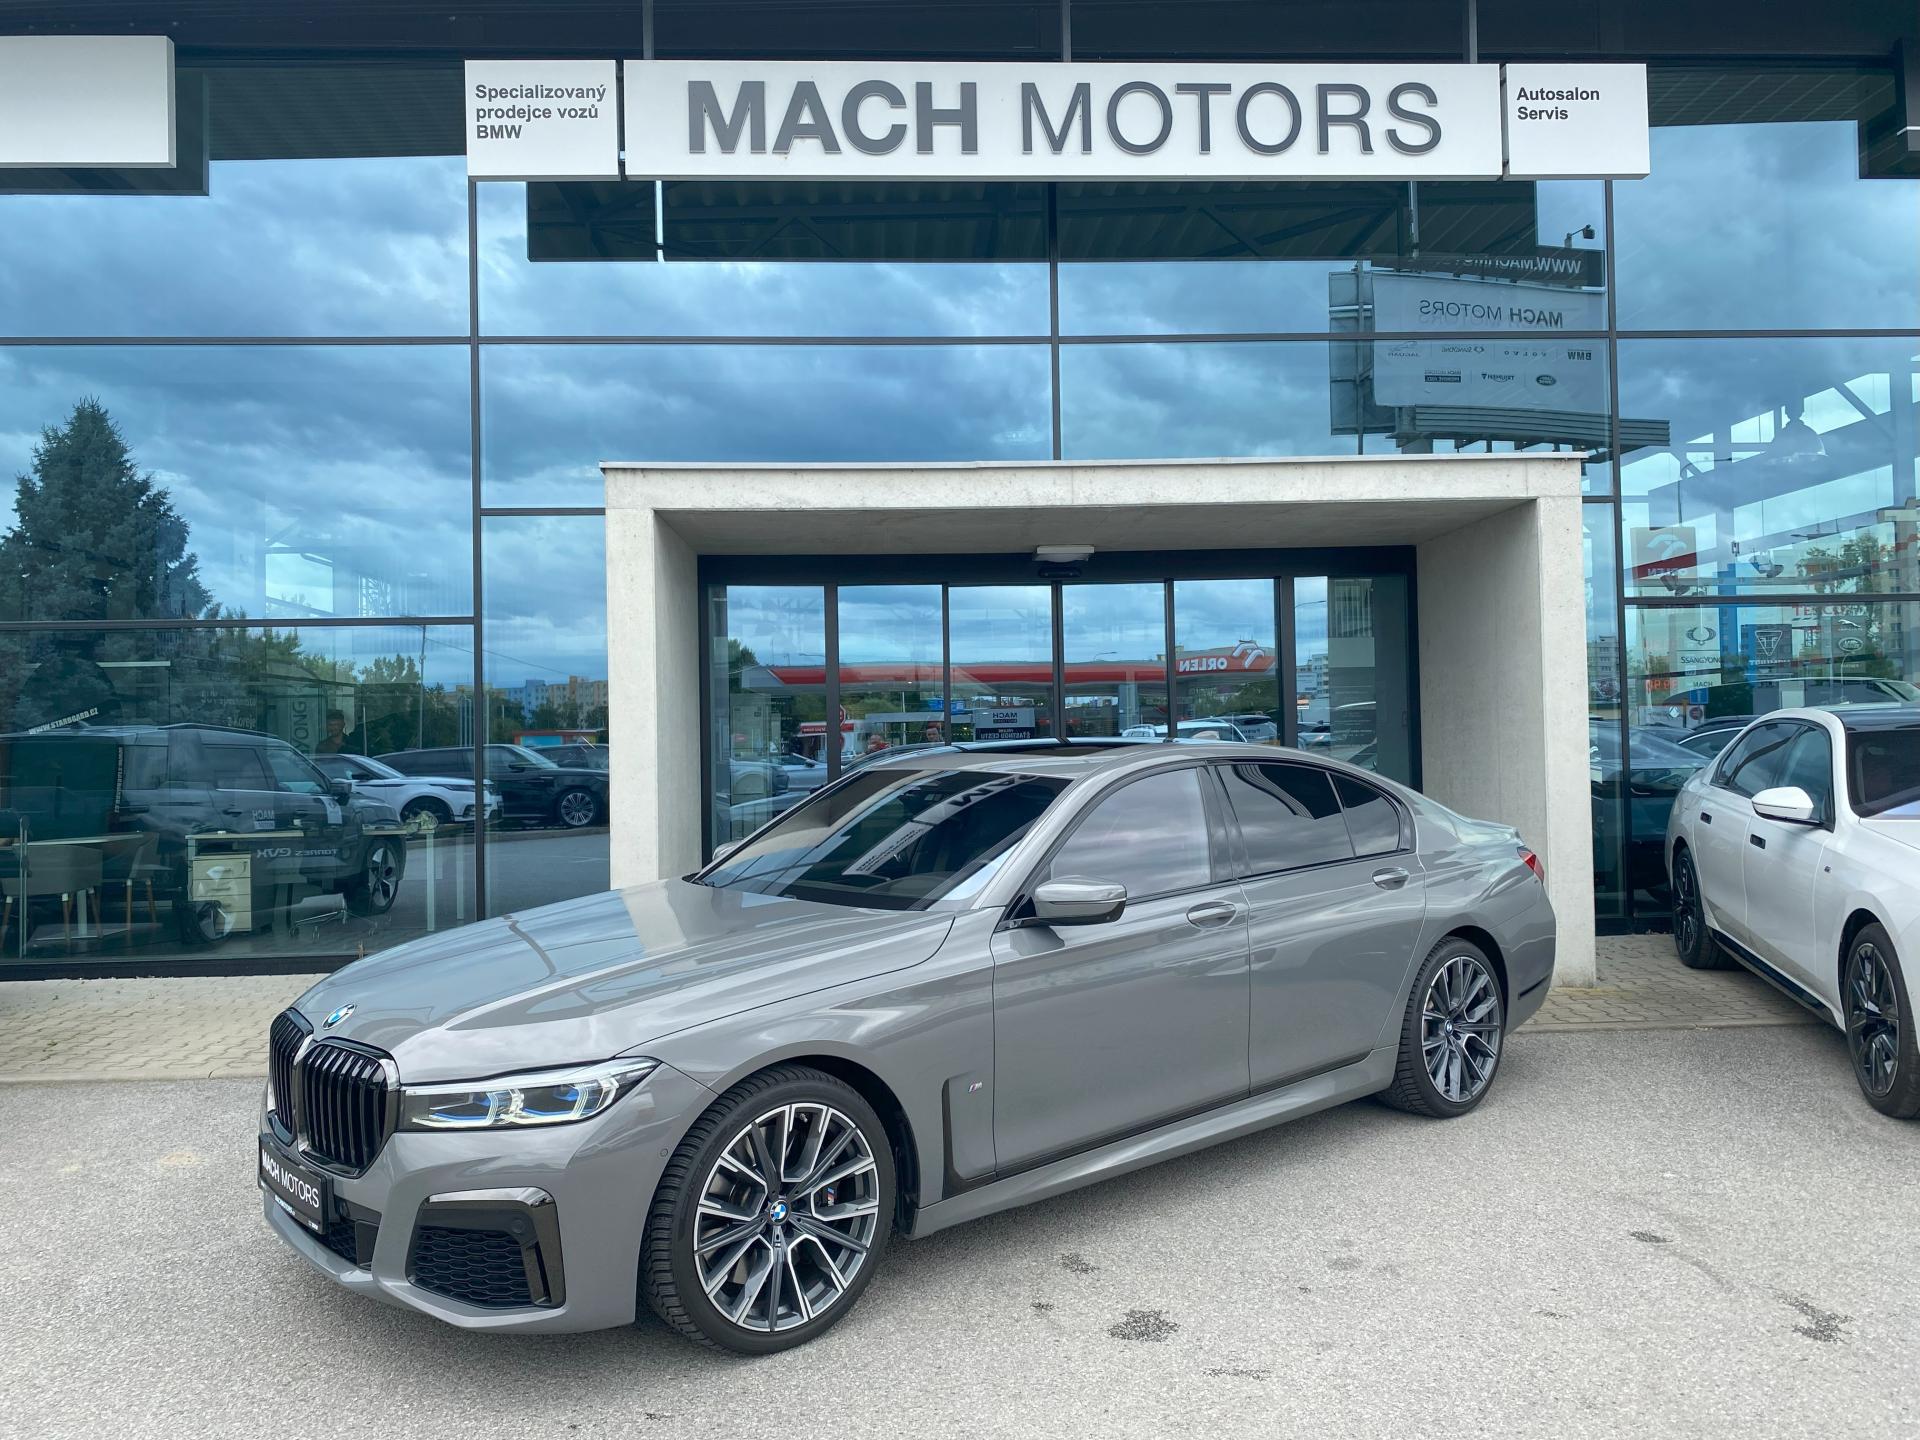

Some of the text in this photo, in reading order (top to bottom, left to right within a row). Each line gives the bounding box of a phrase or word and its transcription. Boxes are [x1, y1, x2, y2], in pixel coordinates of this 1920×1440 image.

[475, 84, 607, 102] Specializovaný
[1516, 87, 1600, 101] Autosalon
[476, 104, 599, 122] prodejce vozů
[687, 80, 1443, 155] MACH MOTORS
[1517, 106, 1569, 120] Servis
[476, 124, 523, 139] BMW
[261, 1148, 280, 1183] MACH
[281, 1167, 320, 1209] MOTORS
